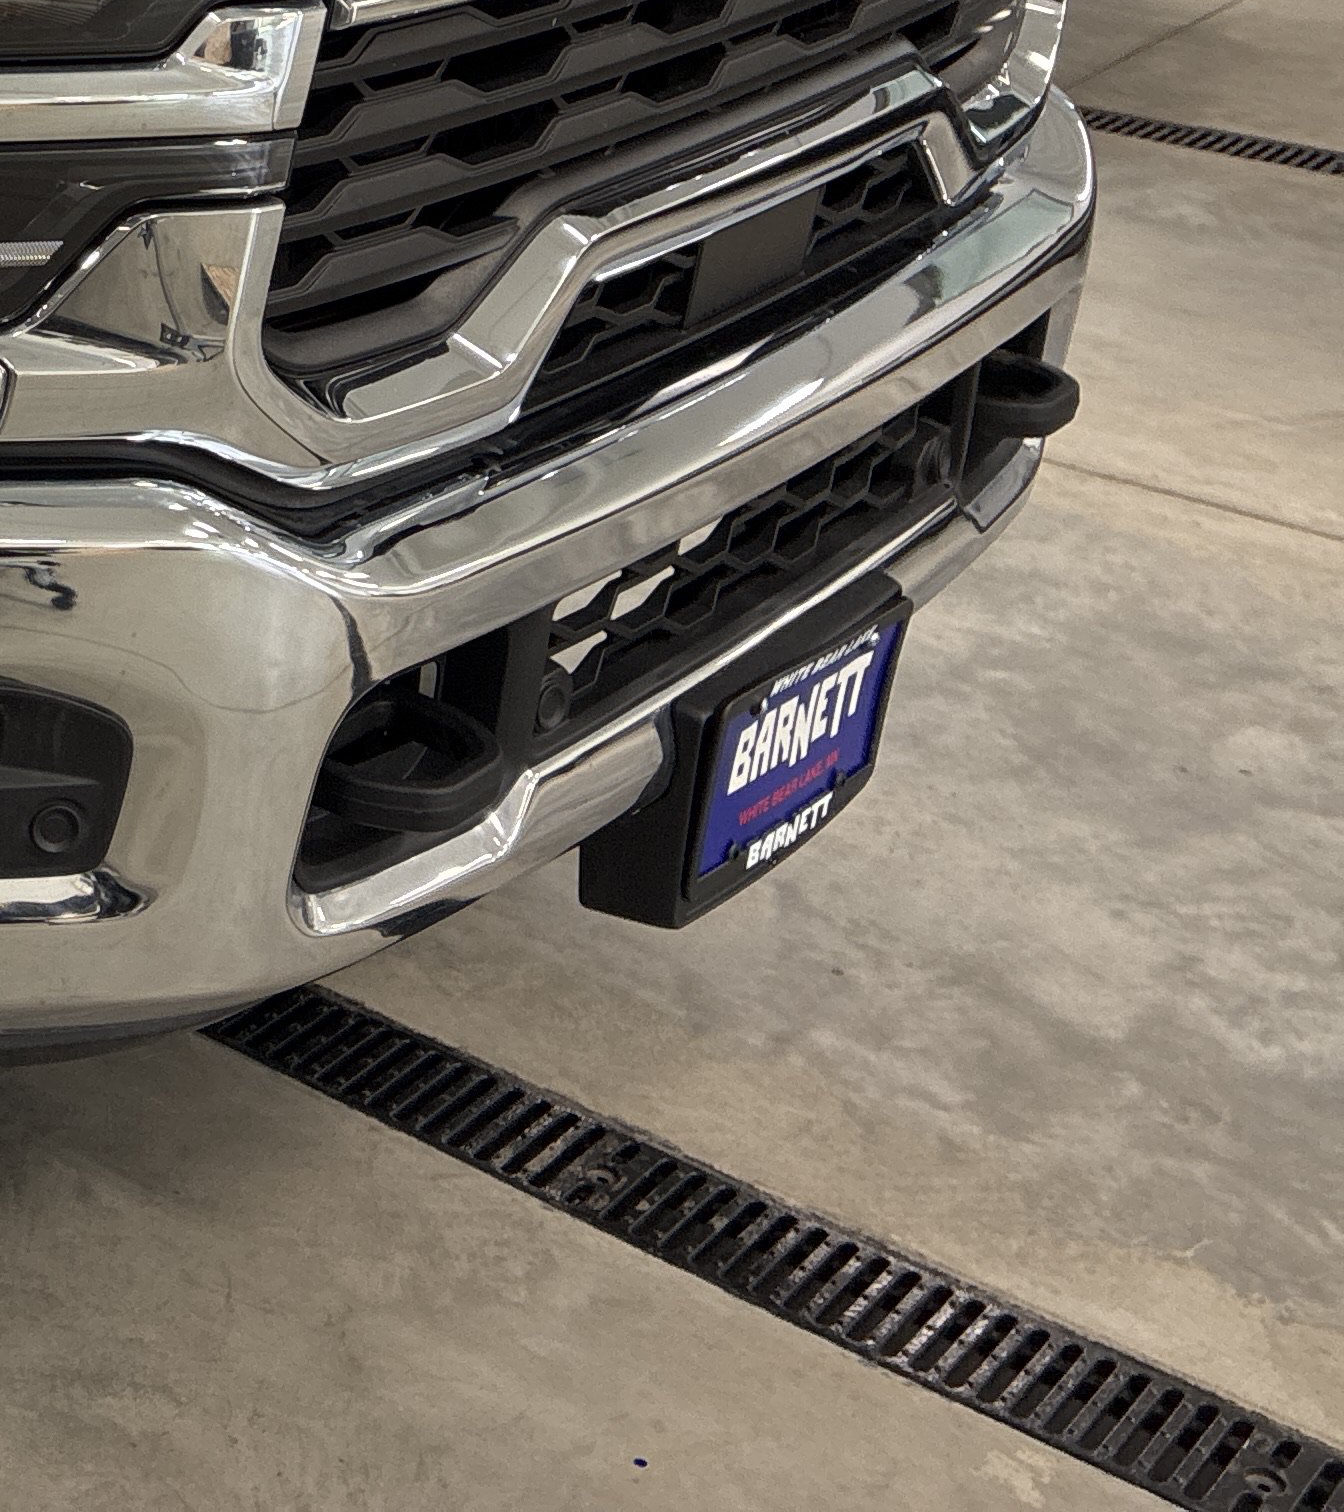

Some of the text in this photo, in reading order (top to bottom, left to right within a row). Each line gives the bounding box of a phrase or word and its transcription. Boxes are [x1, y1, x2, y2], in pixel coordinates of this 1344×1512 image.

[770, 661, 816, 698] WHITE
[811, 643, 848, 675] BEAR
[727, 650, 875, 797] BARNETT
[738, 795, 771, 826] WHITE
[771, 776, 799, 807] BEAR
[746, 791, 834, 870] BARNETT
